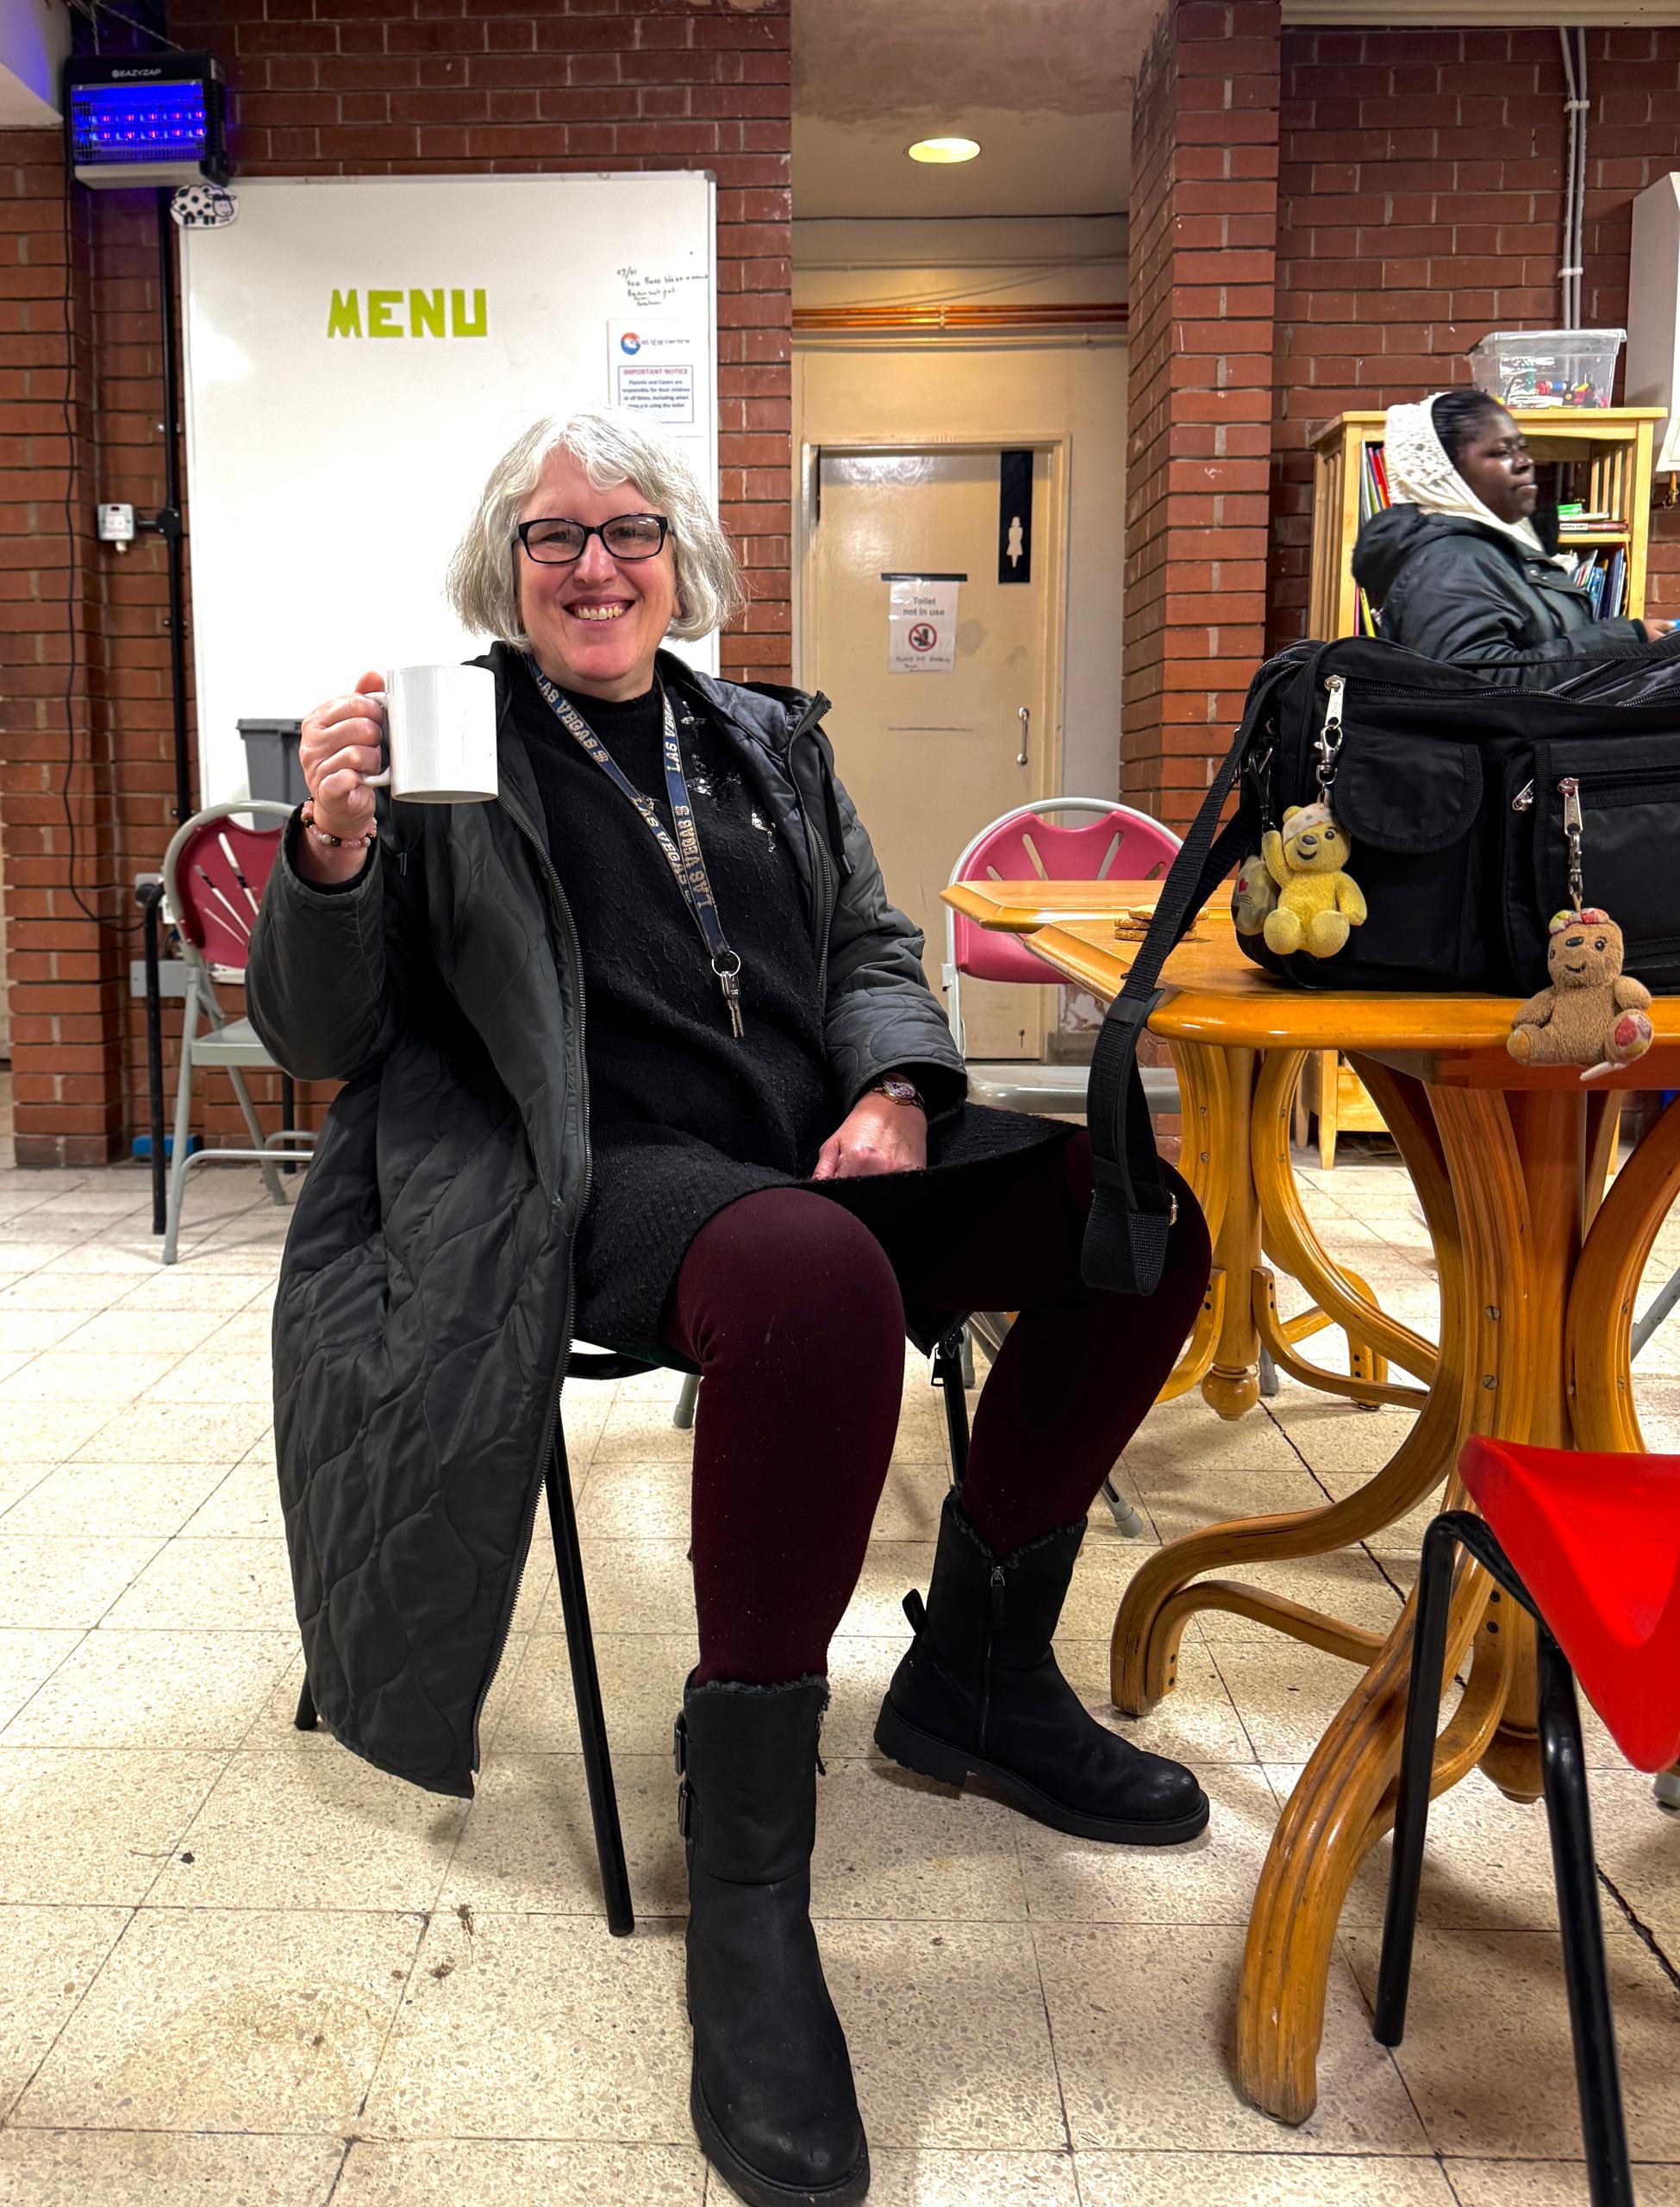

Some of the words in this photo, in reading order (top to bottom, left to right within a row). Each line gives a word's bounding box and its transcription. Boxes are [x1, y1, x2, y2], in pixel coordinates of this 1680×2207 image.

[328, 289, 488, 338] MENU
[536, 673, 559, 703] LAS
[556, 699, 598, 749] VEGAS
[665, 741, 681, 772] LAS
[630, 797, 659, 828] LAS
[657, 831, 688, 885] VEGAS
[678, 819, 702, 869] VEGAS
[690, 870, 714, 910] LAS
